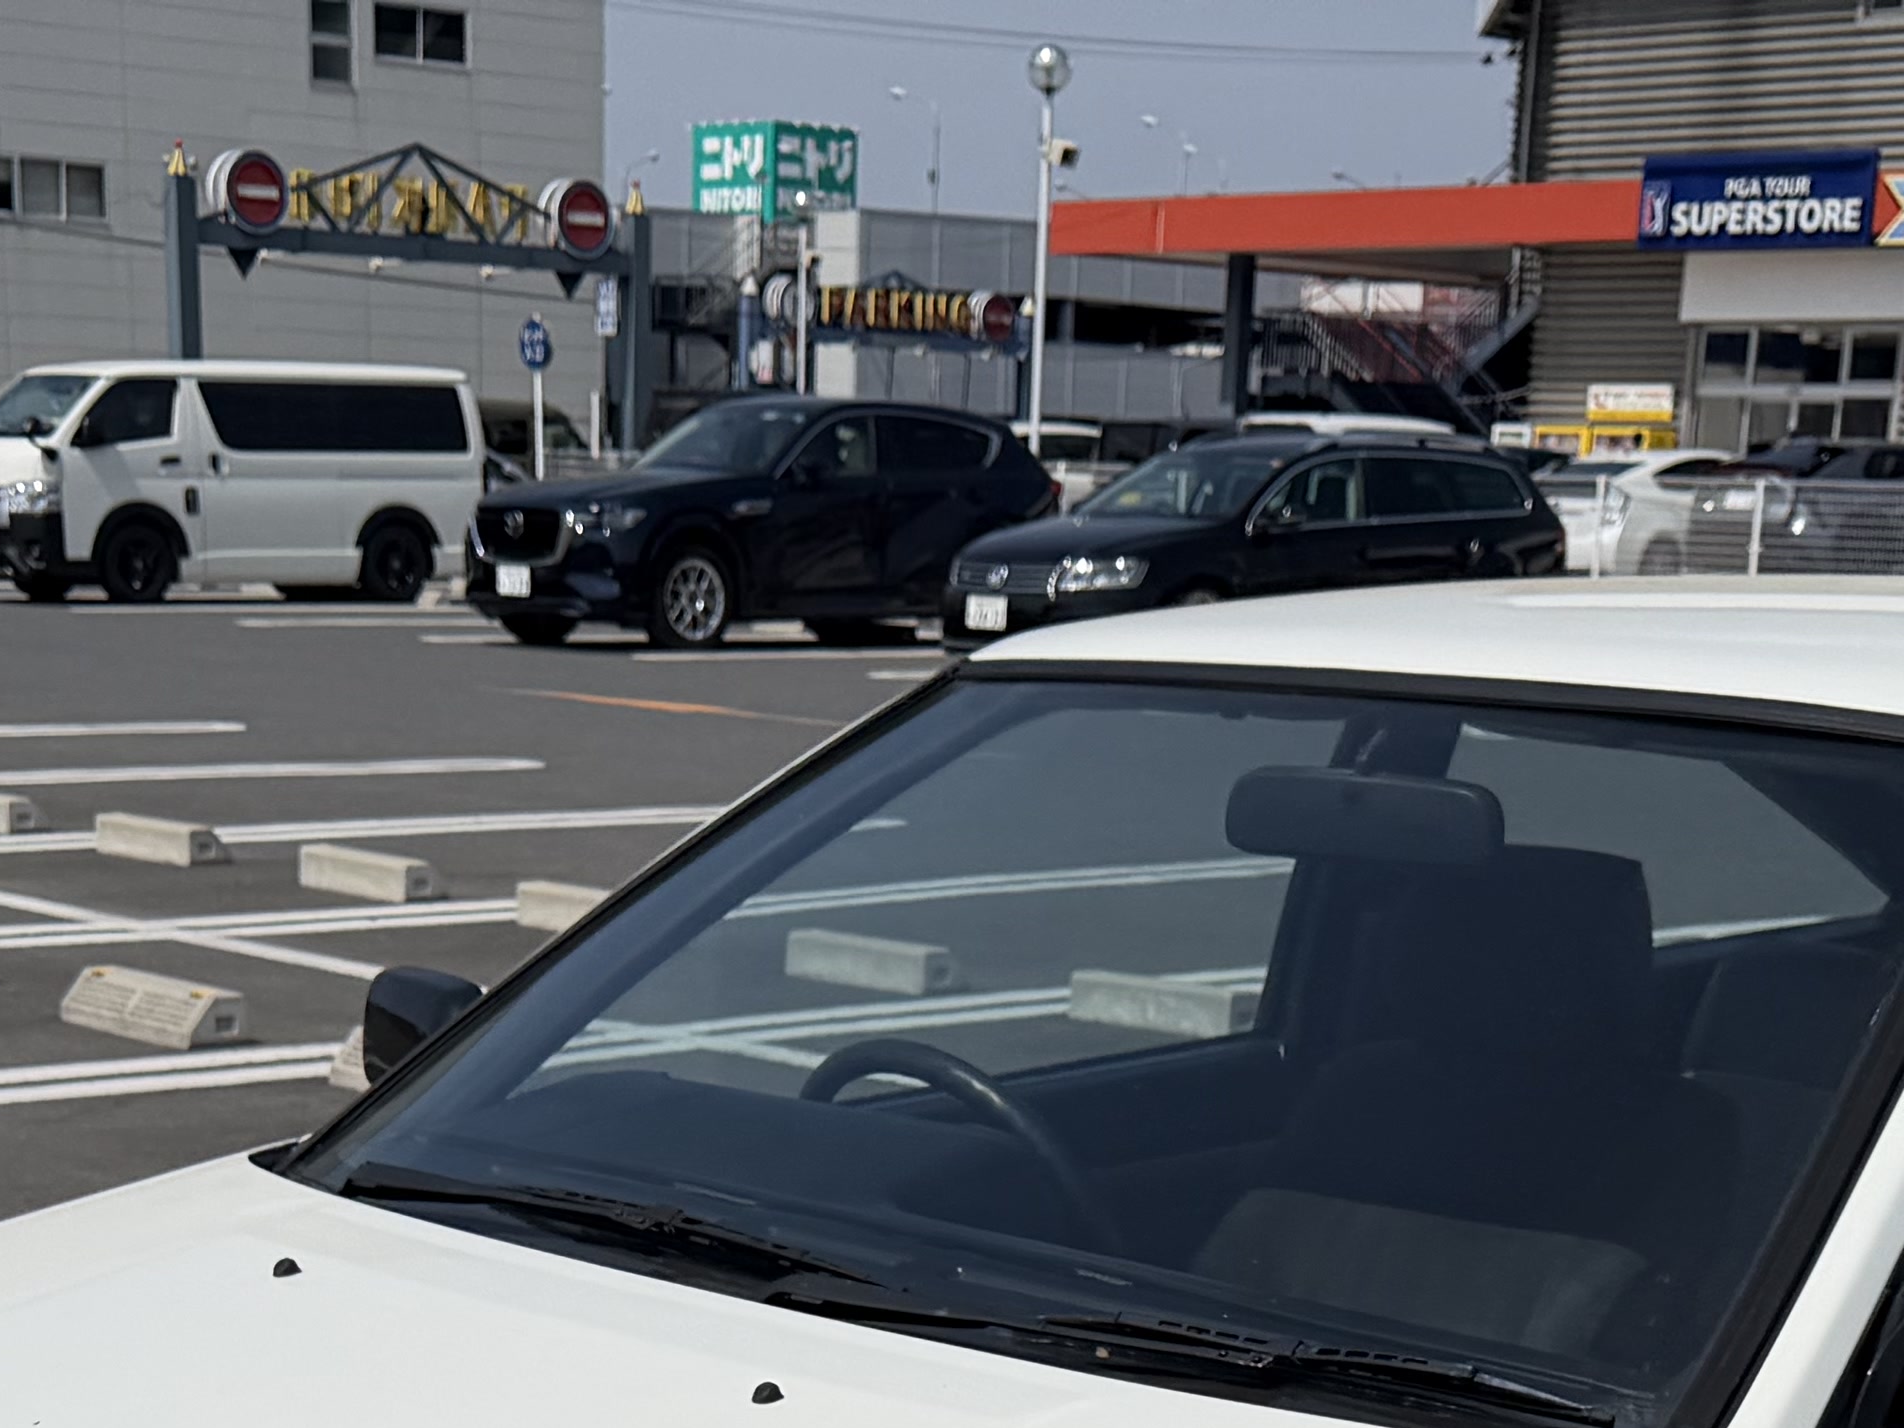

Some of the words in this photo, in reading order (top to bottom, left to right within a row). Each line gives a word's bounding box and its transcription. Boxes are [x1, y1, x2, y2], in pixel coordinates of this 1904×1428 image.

[700, 133, 764, 180] ニトリ
[777, 135, 854, 184] ニトリ
[1762, 175, 1812, 198] TOUR
[1669, 197, 1863, 238] SUPERSTORE
